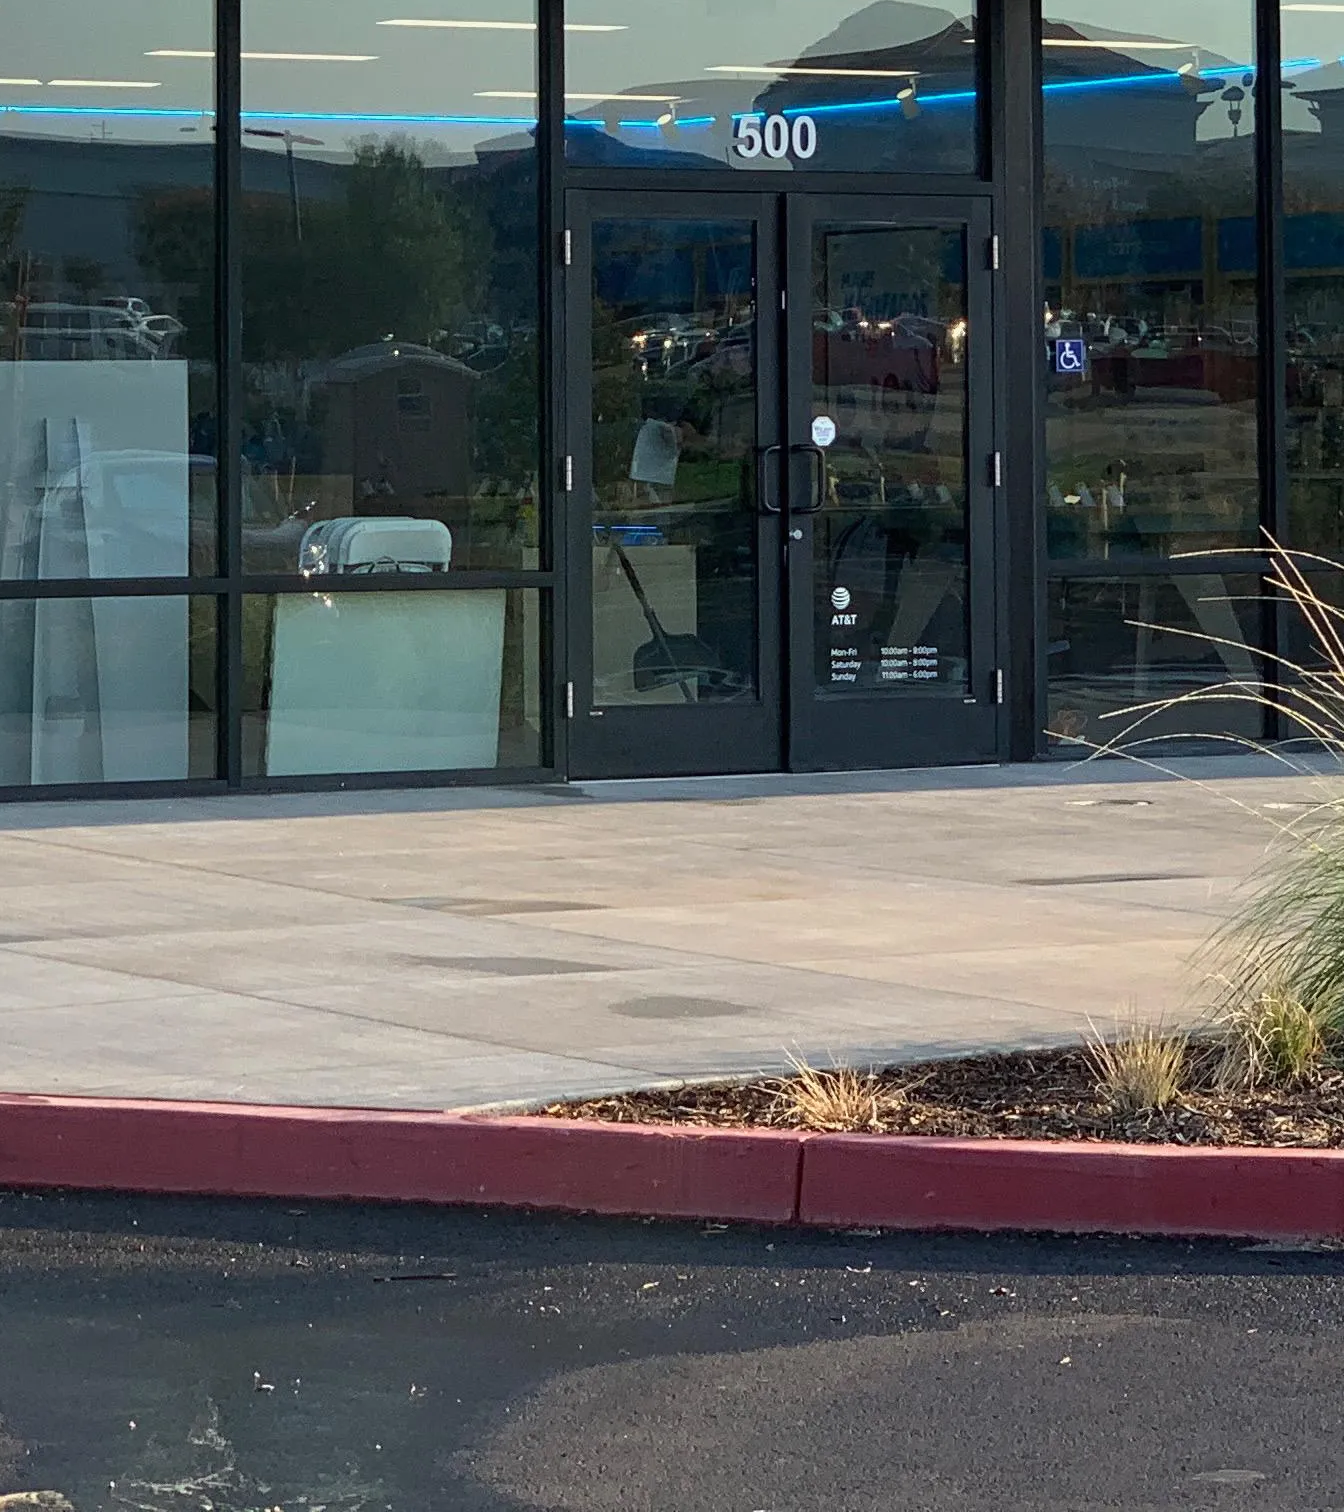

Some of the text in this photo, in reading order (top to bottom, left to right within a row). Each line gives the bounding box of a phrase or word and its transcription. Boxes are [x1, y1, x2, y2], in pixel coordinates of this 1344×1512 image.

[735, 114, 817, 159] 500
[831, 614, 858, 625] AT&T
[830, 648, 858, 657] Mon-Fri
[831, 660, 862, 671] Saturday
[831, 671, 857, 682] Sunday
